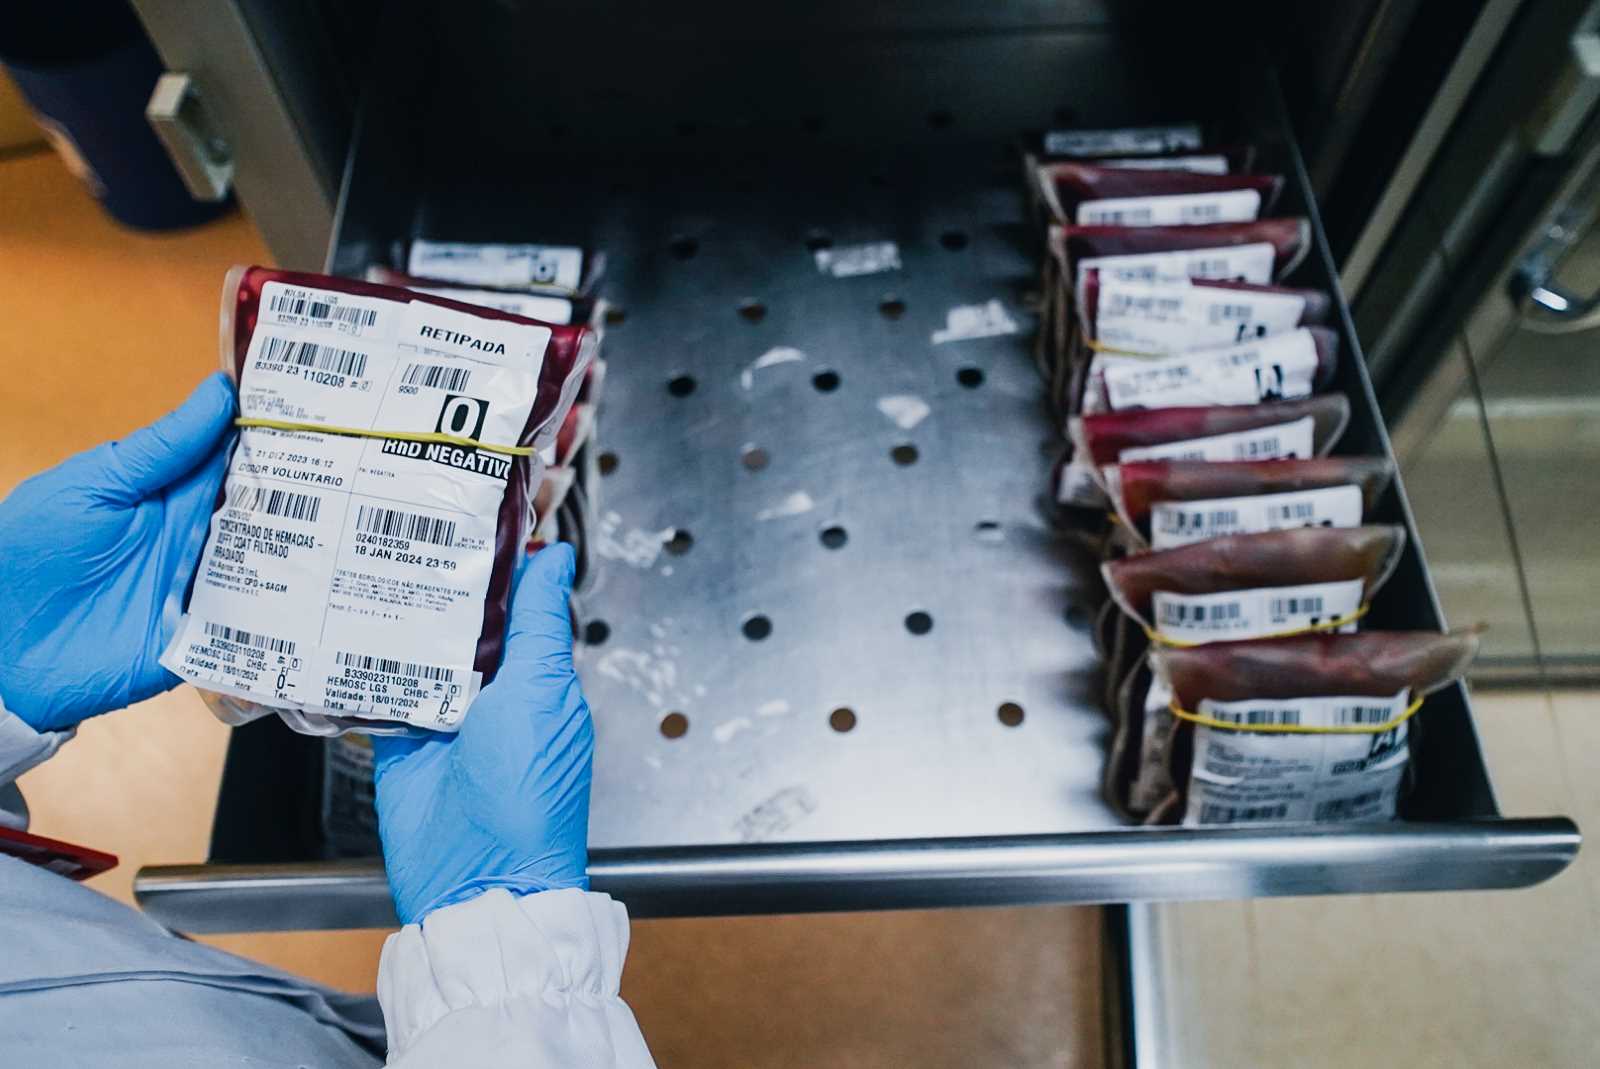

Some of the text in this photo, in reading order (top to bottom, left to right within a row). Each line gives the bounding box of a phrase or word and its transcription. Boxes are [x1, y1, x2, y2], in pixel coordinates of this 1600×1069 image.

[420, 325, 506, 356] RETIPADA
[286, 365, 300, 376] 23
[303, 370, 345, 388] 110208
[398, 385, 419, 396] 9500
[287, 453, 308, 464] 2023
[272, 466, 344, 487] VOLUNTARIO
[234, 536, 251, 550] COAT
[253, 540, 289, 558] FILTRADO
[263, 527, 273, 541] DE
[275, 530, 315, 549] HEMACIAS
[356, 532, 410, 550] 0240182359
[355, 545, 366, 555] 18
[370, 548, 392, 560] JAN
[396, 552, 422, 565] 2024
[265, 583, 288, 593] SAGM
[246, 658, 268, 672] CHBC
[327, 676, 366, 692] HEMOSC
[369, 683, 388, 694] LGS
[403, 688, 429, 699] CHBC
[344, 668, 419, 688] B339023110208
[325, 688, 419, 708] Validade: 18/01/2024
